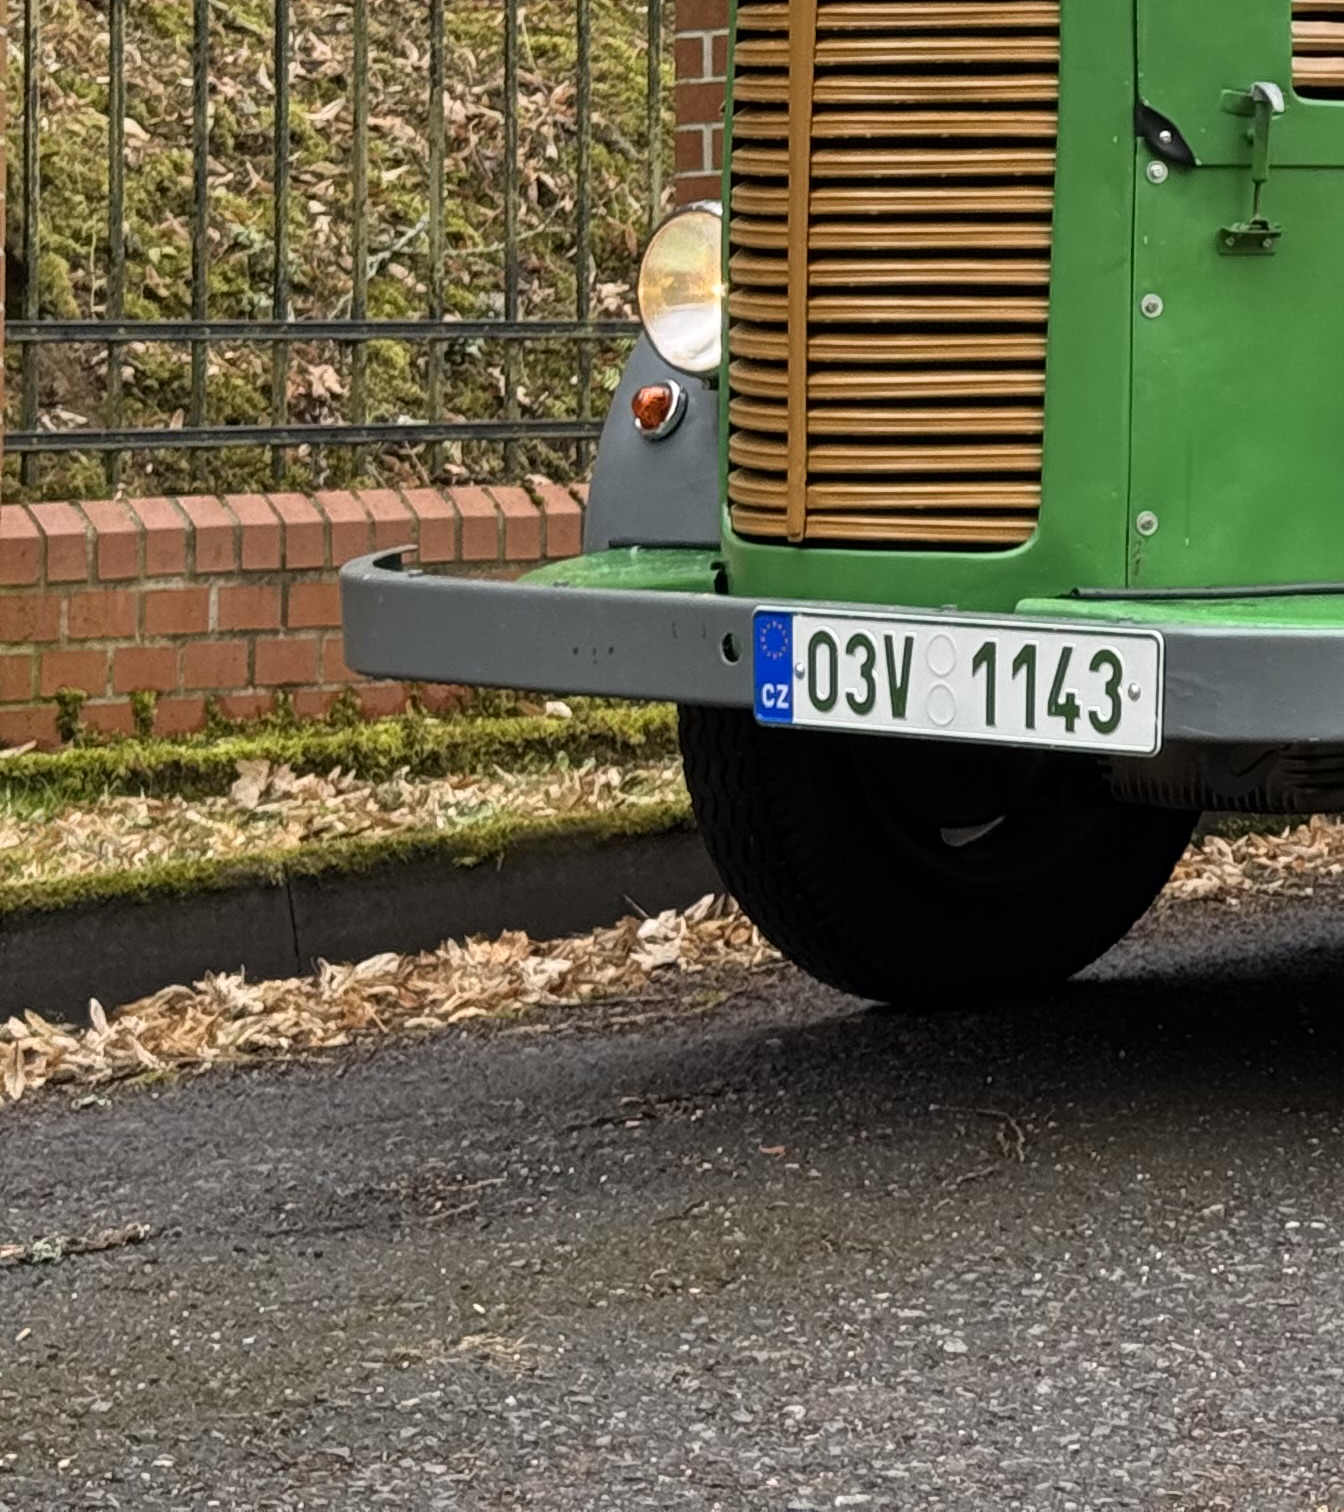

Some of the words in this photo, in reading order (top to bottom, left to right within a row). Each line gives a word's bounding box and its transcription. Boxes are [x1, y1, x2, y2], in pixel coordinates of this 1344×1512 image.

[761, 682, 790, 709] CZ
[807, 630, 914, 719] 03V
[972, 640, 1124, 735] 1143
